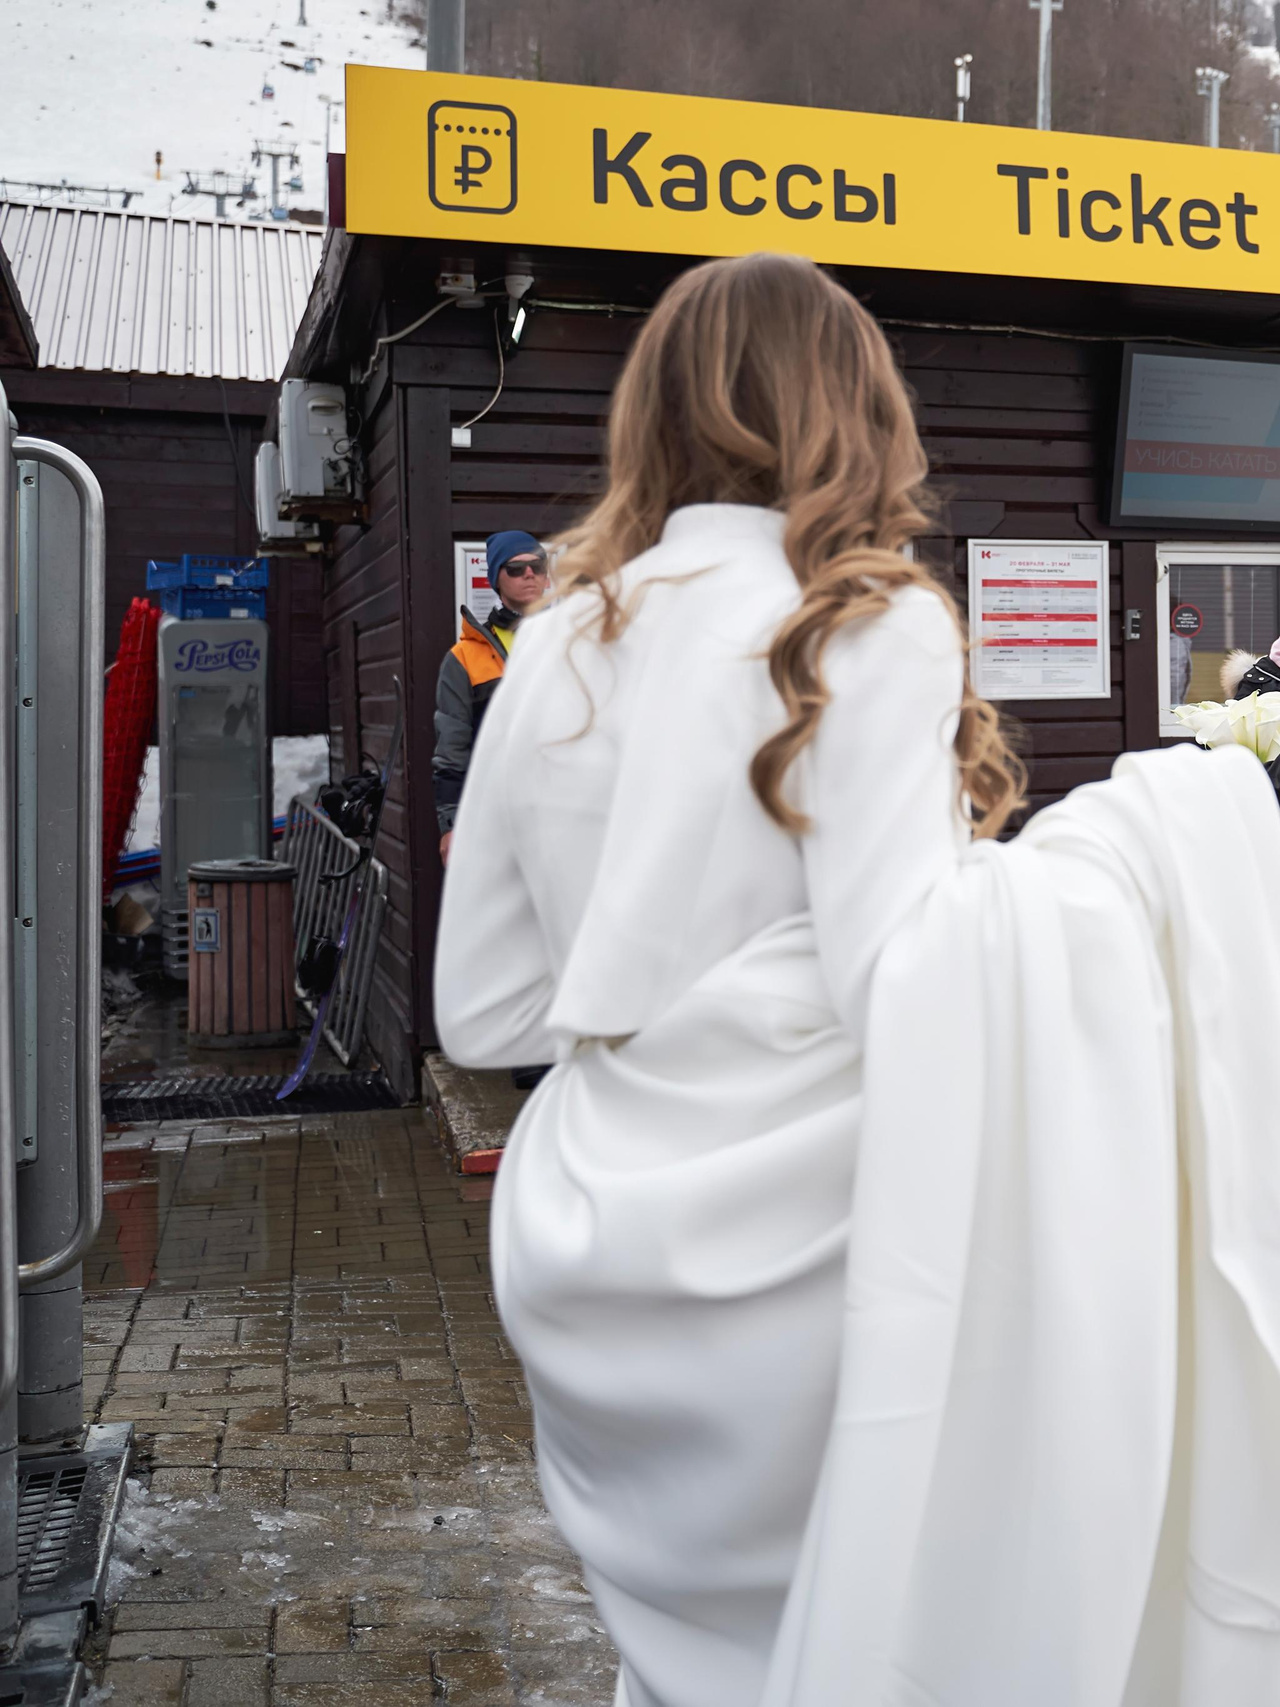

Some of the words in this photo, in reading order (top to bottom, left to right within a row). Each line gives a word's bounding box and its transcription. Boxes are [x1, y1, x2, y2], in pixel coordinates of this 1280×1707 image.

[592, 128, 896, 225] Кассы
[997, 164, 1260, 254] Ticket
[1135, 447, 1203, 468] УЧИСЬ
[1208, 453, 1278, 473] КАТАТЬ
